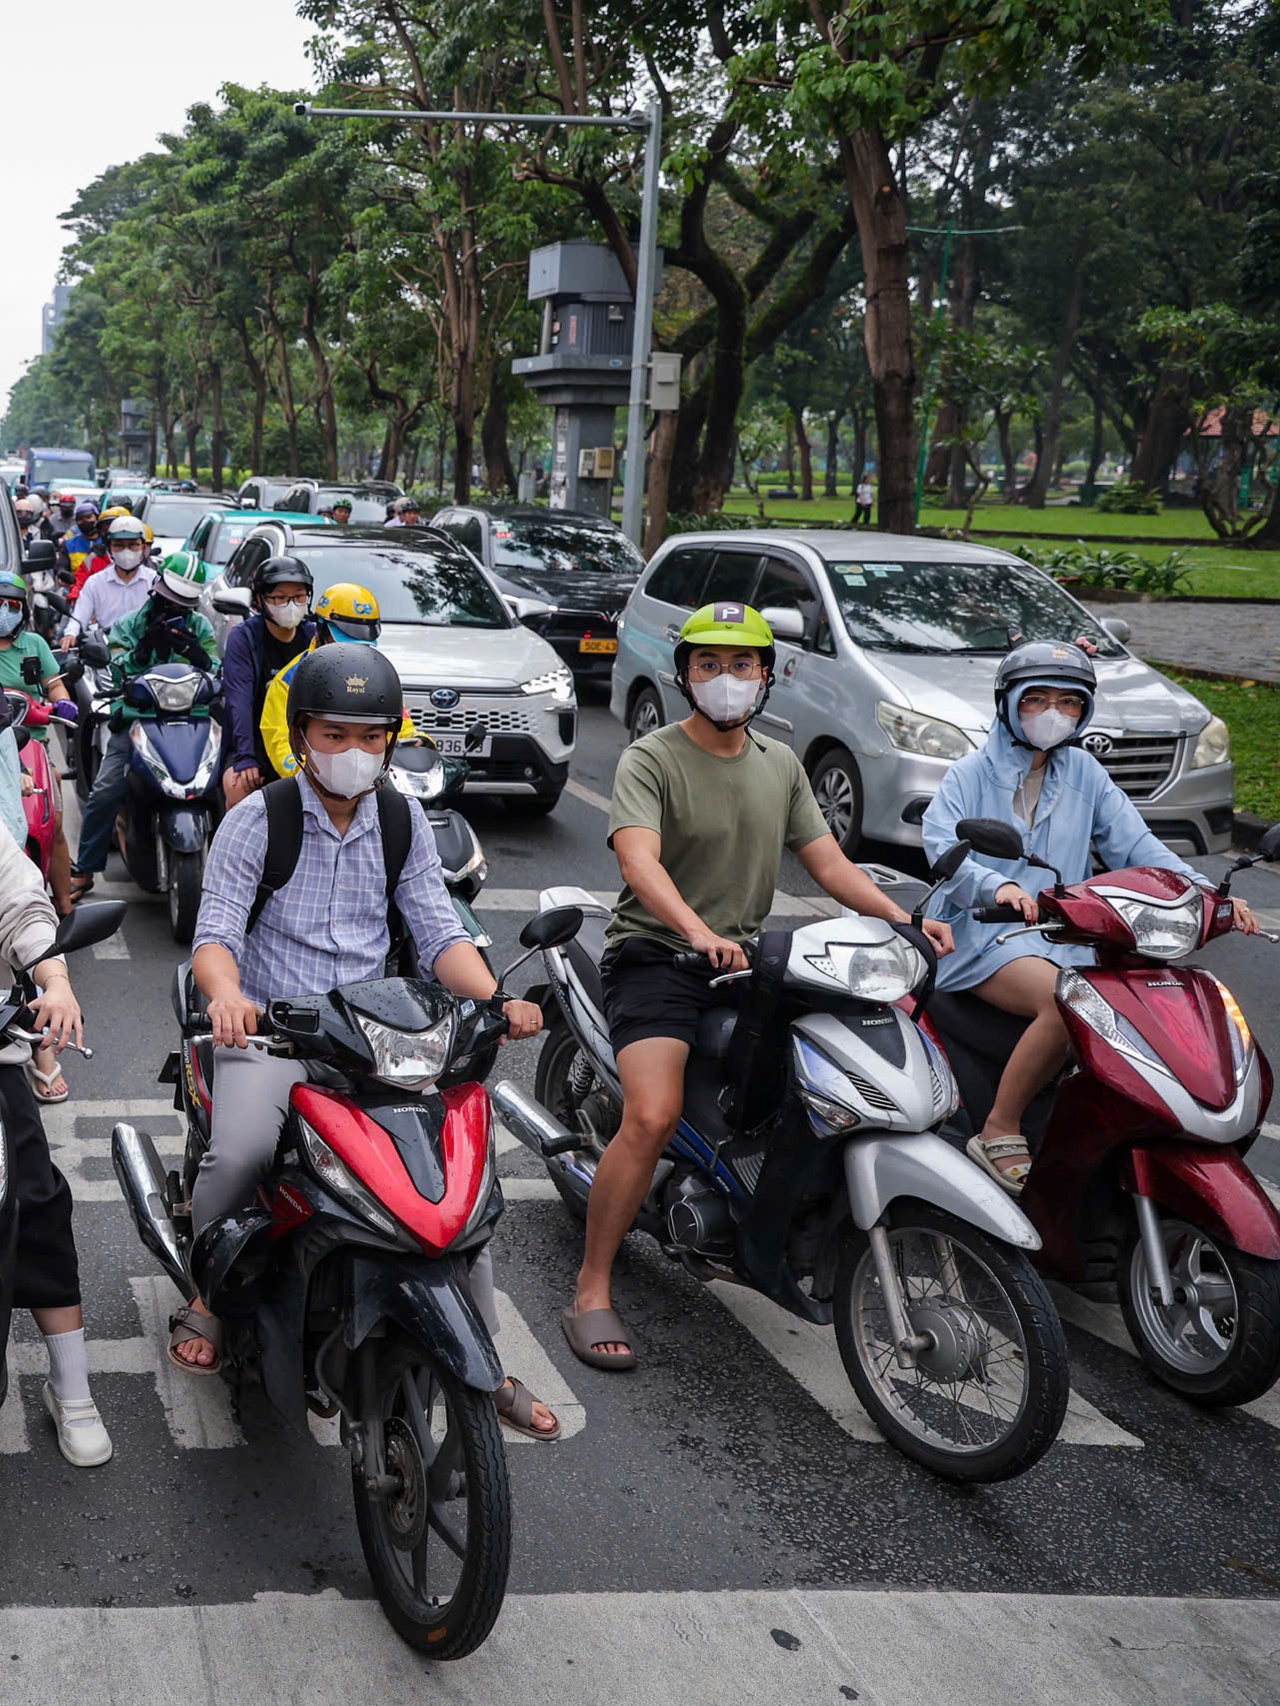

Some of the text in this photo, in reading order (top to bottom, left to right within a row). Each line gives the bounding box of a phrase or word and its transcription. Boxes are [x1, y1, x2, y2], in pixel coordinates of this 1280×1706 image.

[354, 599, 374, 615] be
[722, 607, 740, 620] P
[346, 686, 366, 695] Royal
[1147, 981, 1186, 989] HONDA
[862, 1016, 895, 1027] HONDA
[393, 1106, 429, 1114] HONDA
[278, 1185, 305, 1215] HONDA
